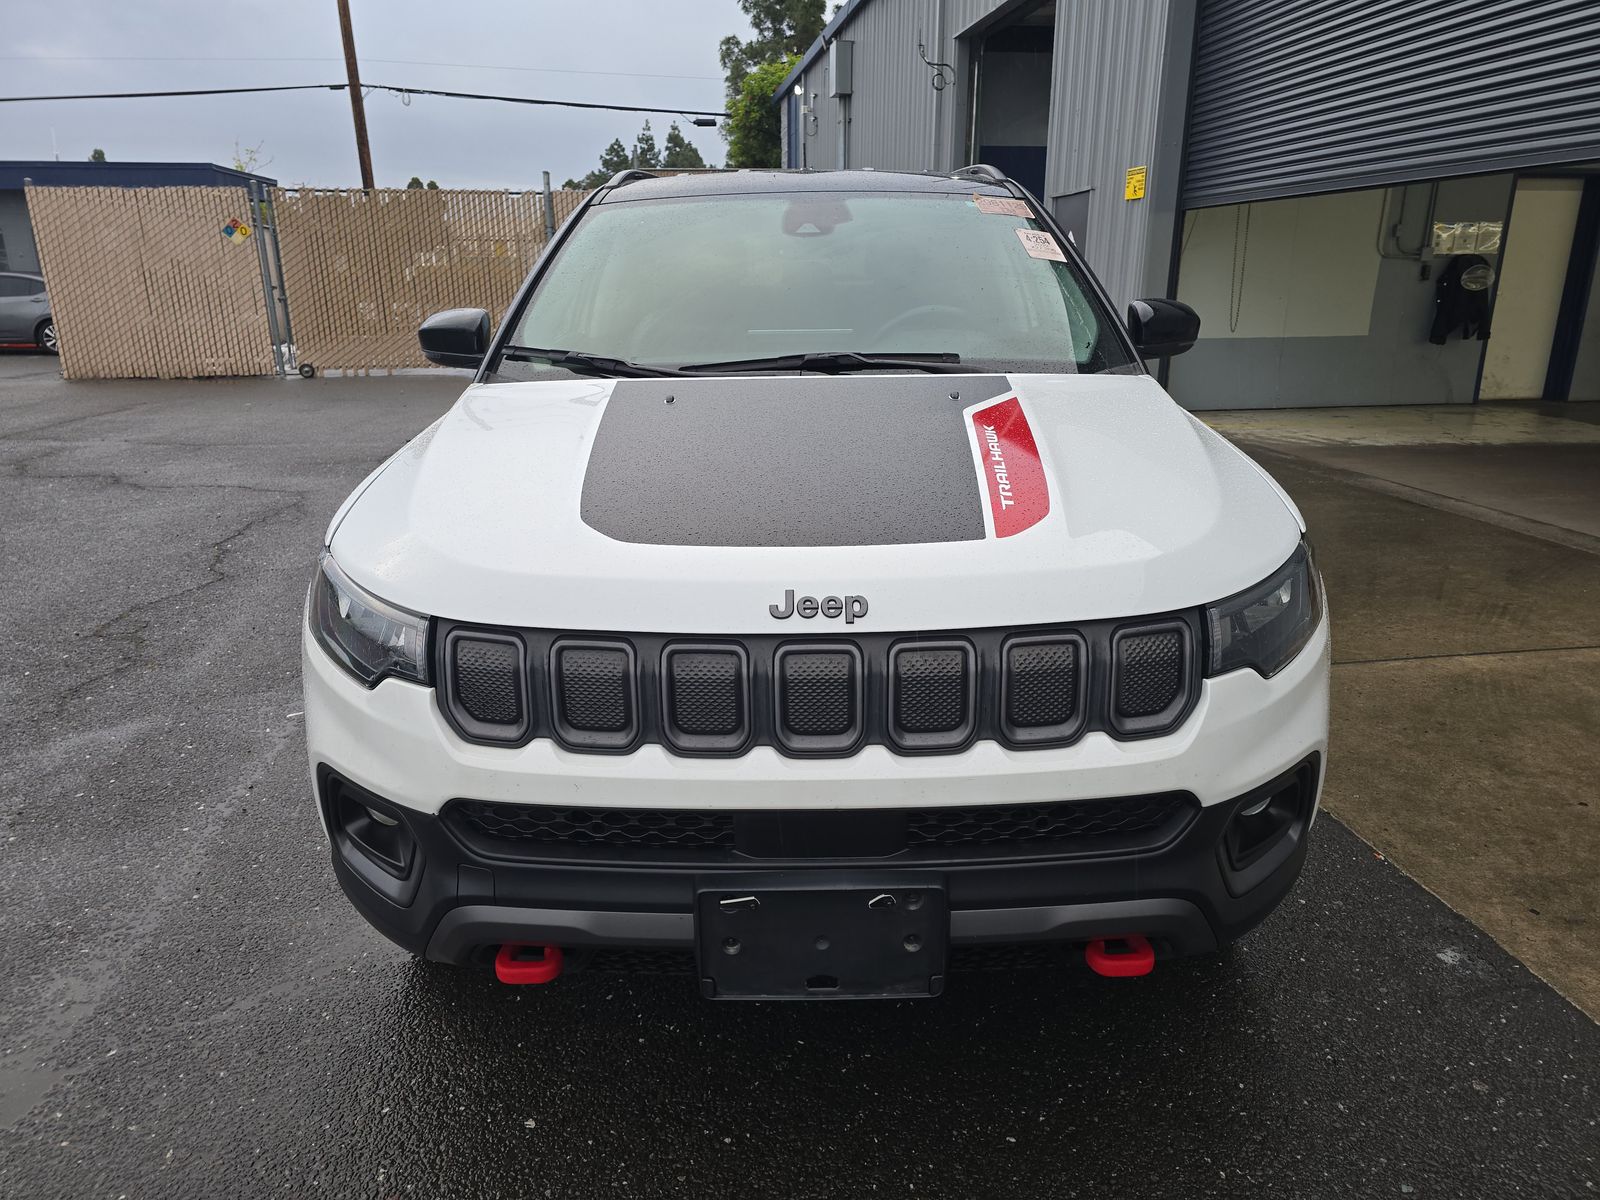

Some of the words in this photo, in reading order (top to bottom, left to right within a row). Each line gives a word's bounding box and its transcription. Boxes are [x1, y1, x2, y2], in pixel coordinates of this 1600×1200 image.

[232, 219, 239, 228] 2
[240, 226, 247, 235] 0
[983, 424, 1014, 510] TRAILHAWK
[769, 589, 868, 624] Jeep
